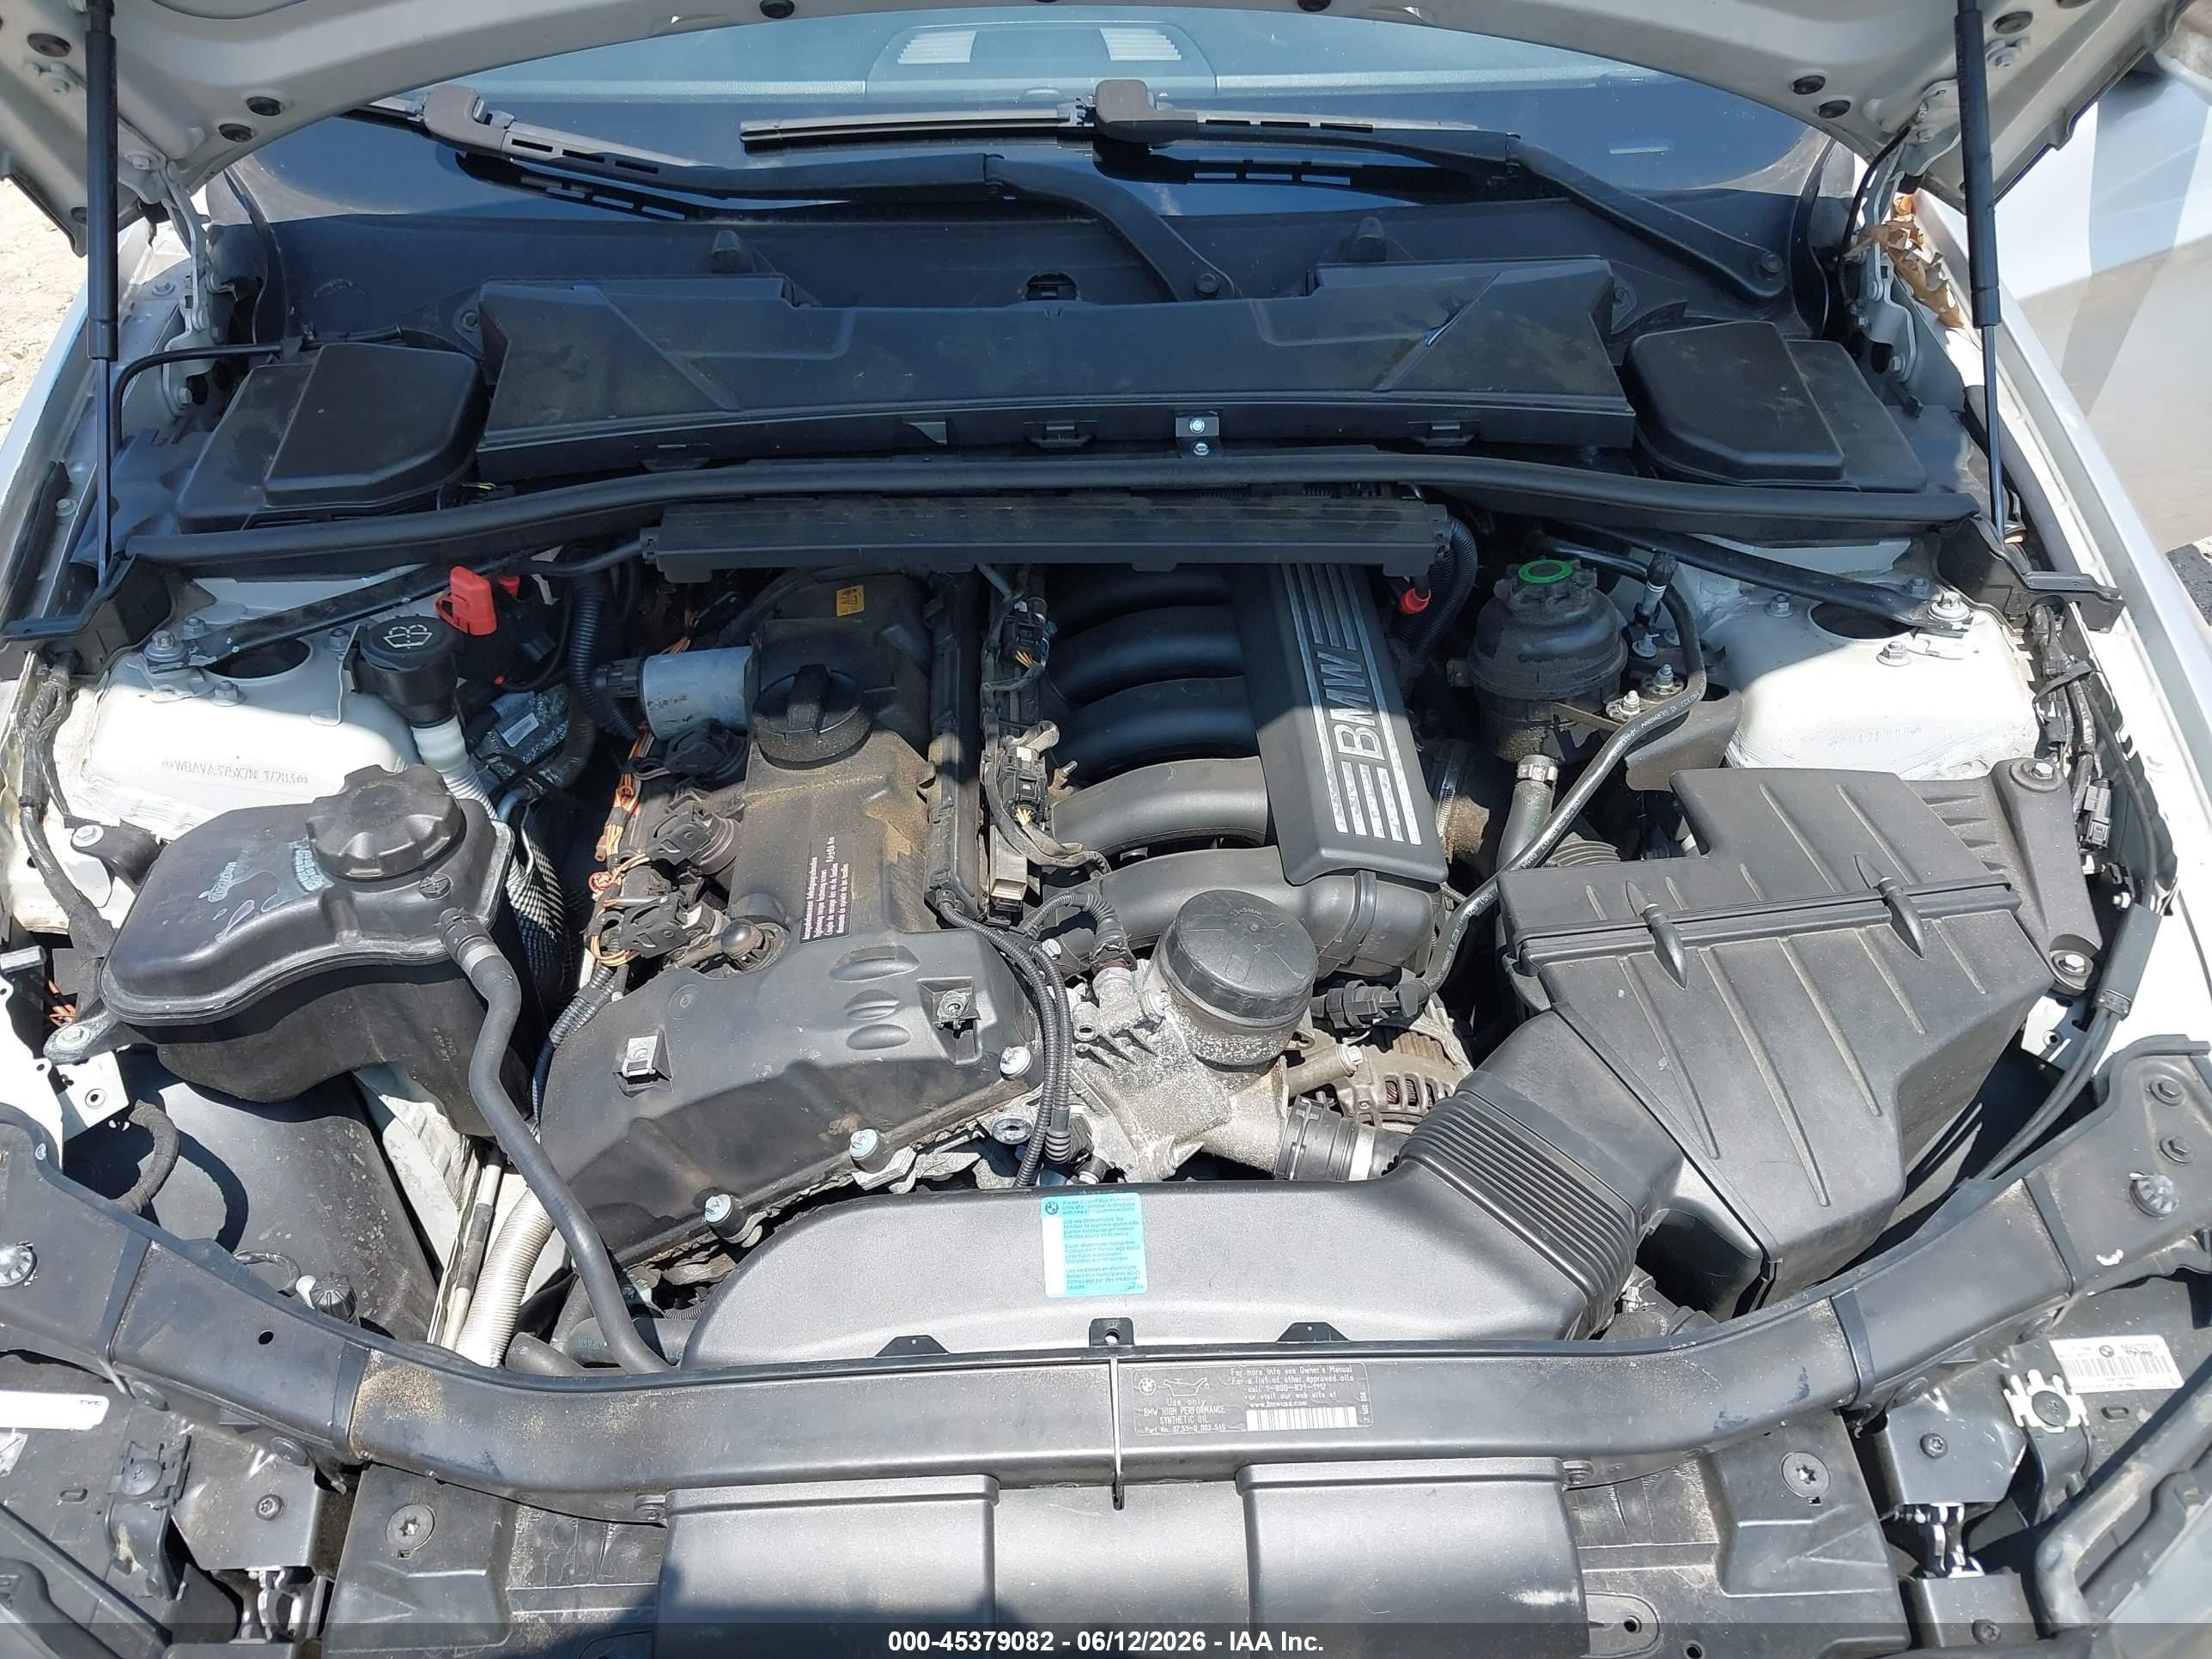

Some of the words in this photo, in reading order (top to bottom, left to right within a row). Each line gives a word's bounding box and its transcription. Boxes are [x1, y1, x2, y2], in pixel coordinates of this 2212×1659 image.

[1316, 651, 1385, 761] BMW
[1306, 1374, 1336, 1384] approved
[1167, 1398, 1182, 1407] Use
[1187, 1397, 1207, 1407] only
[1143, 1408, 1158, 1417] BMW
[1180, 1406, 1225, 1415] PERFORMANCE
[1159, 1415, 1194, 1425] SYNTHETIC
[1198, 1415, 1209, 1424] OIL
